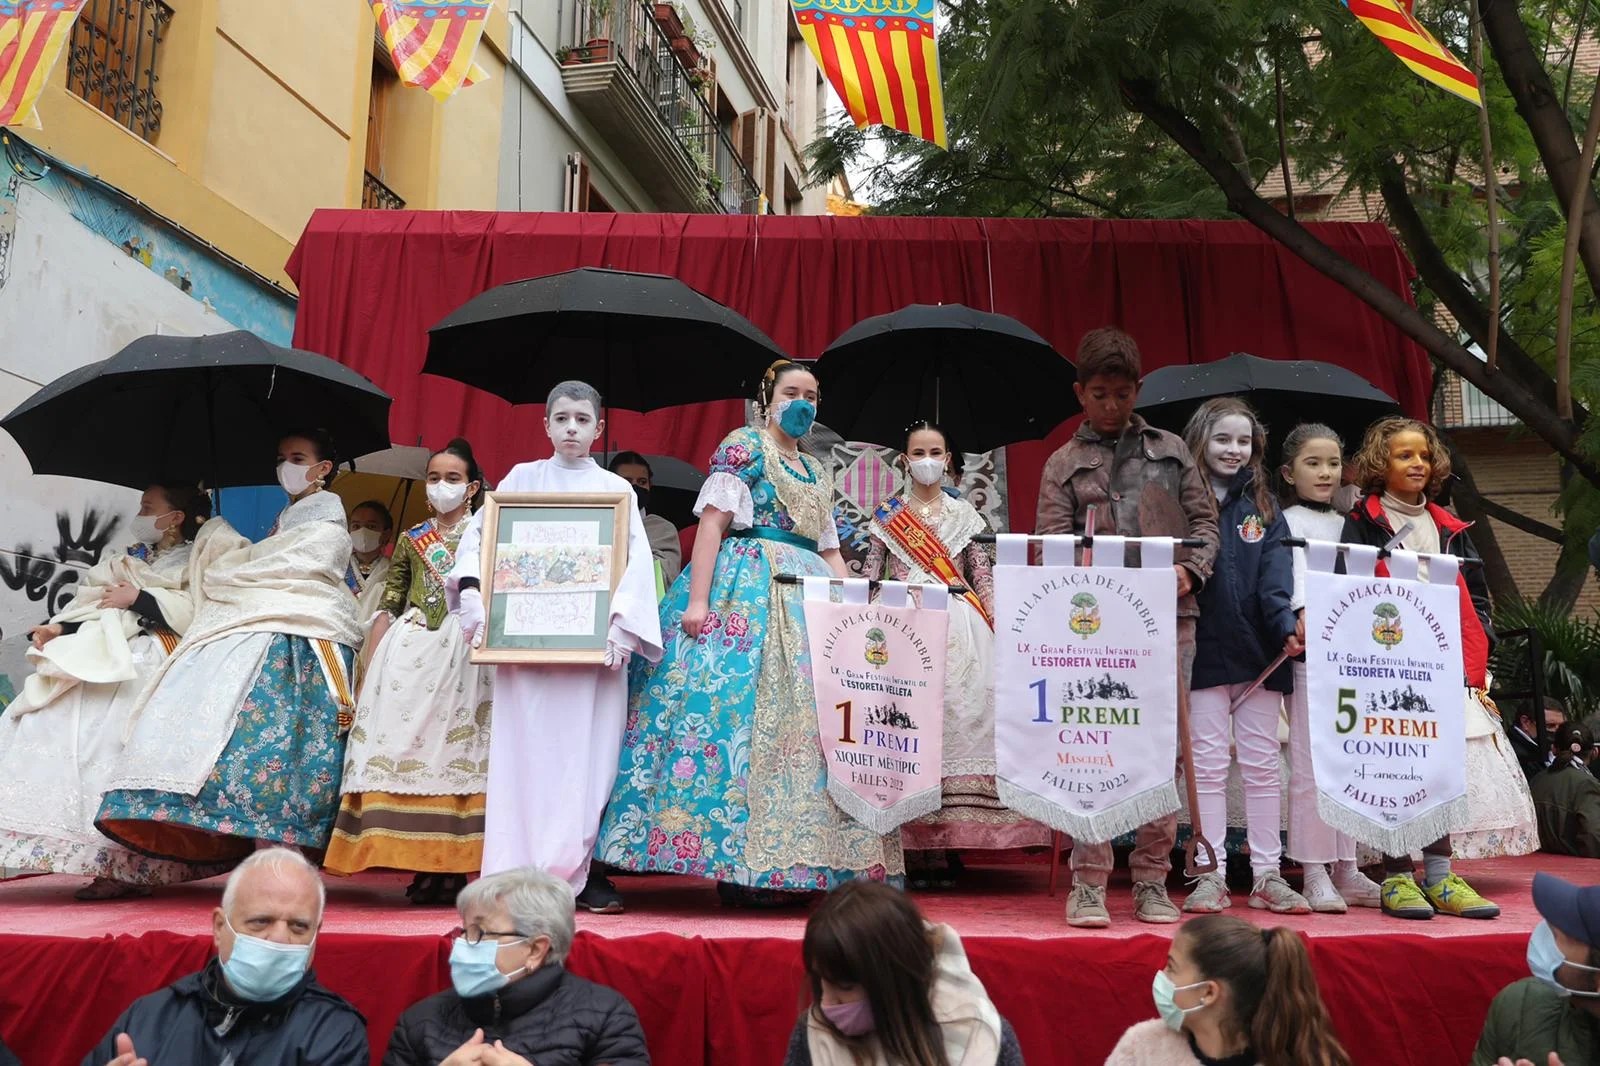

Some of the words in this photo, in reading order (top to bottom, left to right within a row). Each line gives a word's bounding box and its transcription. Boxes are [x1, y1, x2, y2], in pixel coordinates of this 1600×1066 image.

[1012, 592, 1042, 633] FALLA
[1042, 573, 1090, 594] PLAÇA
[1096, 575, 1117, 589] DE
[1118, 584, 1159, 637] L'ARBRE
[1322, 600, 1349, 641] FALLA
[1348, 583, 1392, 603] PLAÇA
[1396, 586, 1412, 601] DE
[1414, 597, 1449, 652] L'ARBRE
[823, 626, 842, 659] FALLA
[841, 610, 880, 629] PLAÇA
[884, 614, 901, 628] DE
[901, 624, 933, 672] L'ARBRE
[1018, 643, 1030, 653] LX
[1032, 656, 1091, 668] L'ESTORETA
[1095, 658, 1136, 669] VELLETA
[1327, 651, 1338, 662] LX
[1339, 665, 1395, 678] L'ESTORETA
[1398, 669, 1432, 682] VELLETA
[841, 679, 884, 692] L'ESTORETA
[885, 685, 912, 697] VELLETA
[1029, 678, 1053, 723] 1
[1061, 706, 1140, 725] PREMI
[1335, 688, 1357, 734] 5
[1364, 717, 1438, 738] PREMI
[835, 700, 856, 743] 1
[863, 729, 919, 753] PREMI
[1058, 729, 1112, 744] CANT
[835, 749, 874, 767] XIQUET
[1343, 740, 1429, 758] CONJUNT
[852, 772, 888, 788] FALLES
[1042, 771, 1093, 794] FALLES
[1099, 773, 1129, 792] 2022
[1343, 784, 1397, 808] FALLES
[1403, 788, 1428, 807] 2022
